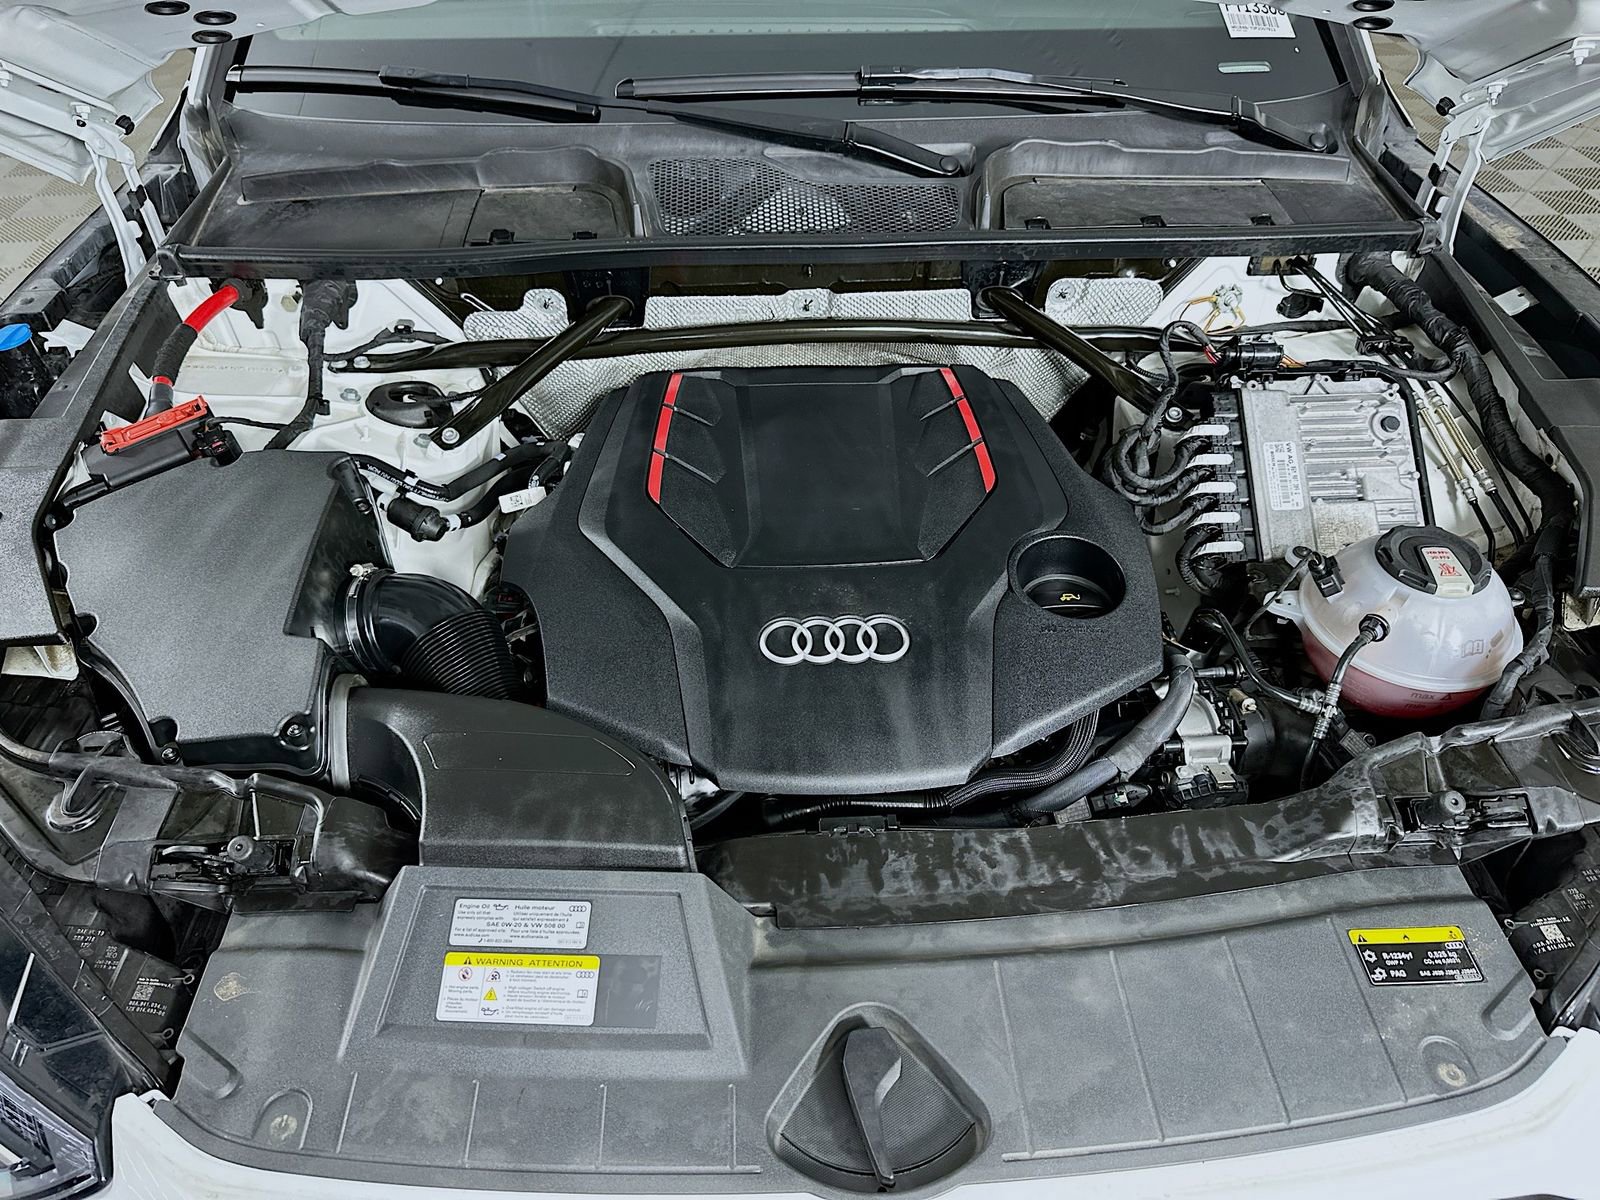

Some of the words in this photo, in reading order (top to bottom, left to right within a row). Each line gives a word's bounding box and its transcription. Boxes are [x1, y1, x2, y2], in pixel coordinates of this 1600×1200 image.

[1411, 692, 1435, 700] max
[476, 958, 524, 966] WARNING
[529, 959, 583, 967] ATTENTION
[1389, 969, 1407, 978] PAG
